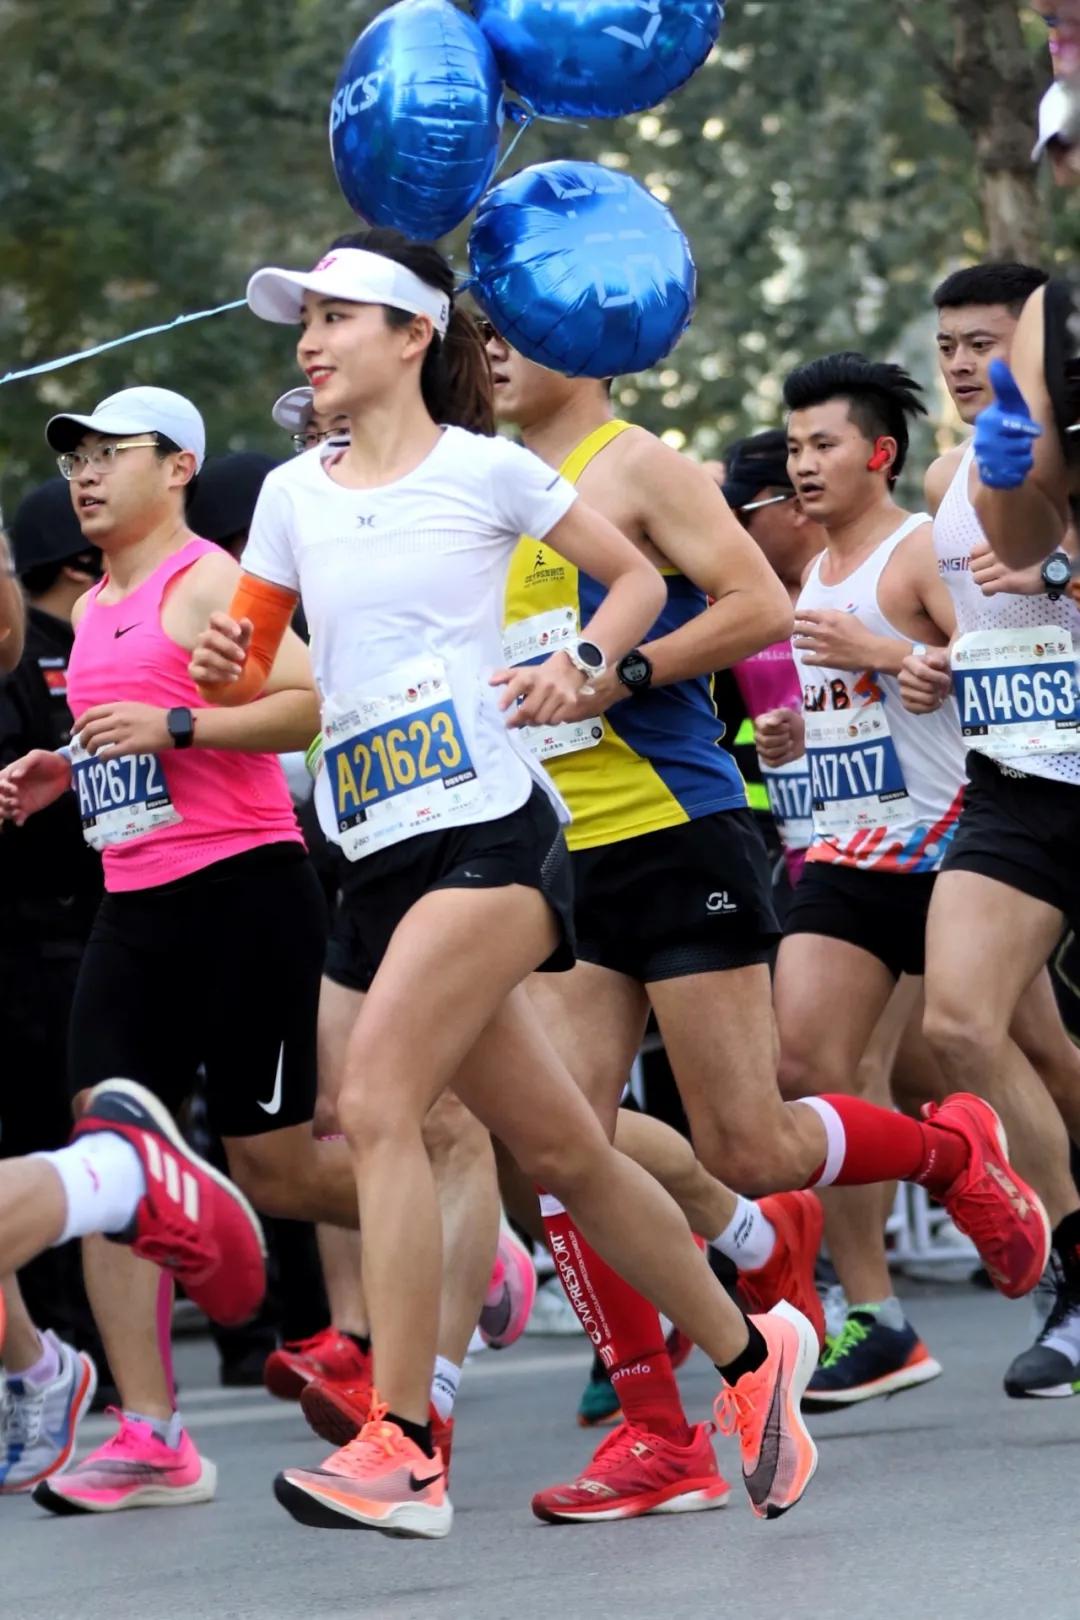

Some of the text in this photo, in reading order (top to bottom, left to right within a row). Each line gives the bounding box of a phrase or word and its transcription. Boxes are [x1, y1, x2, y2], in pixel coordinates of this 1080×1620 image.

[331, 71, 383, 131] SICS
[963, 669, 1075, 722] A14663
[78, 753, 163, 816] A12672
[337, 712, 462, 813] A21623
[811, 745, 884, 798] A17117
[767, 777, 813, 816] A117
[550, 1233, 601, 1345] COMPRESSPORT
